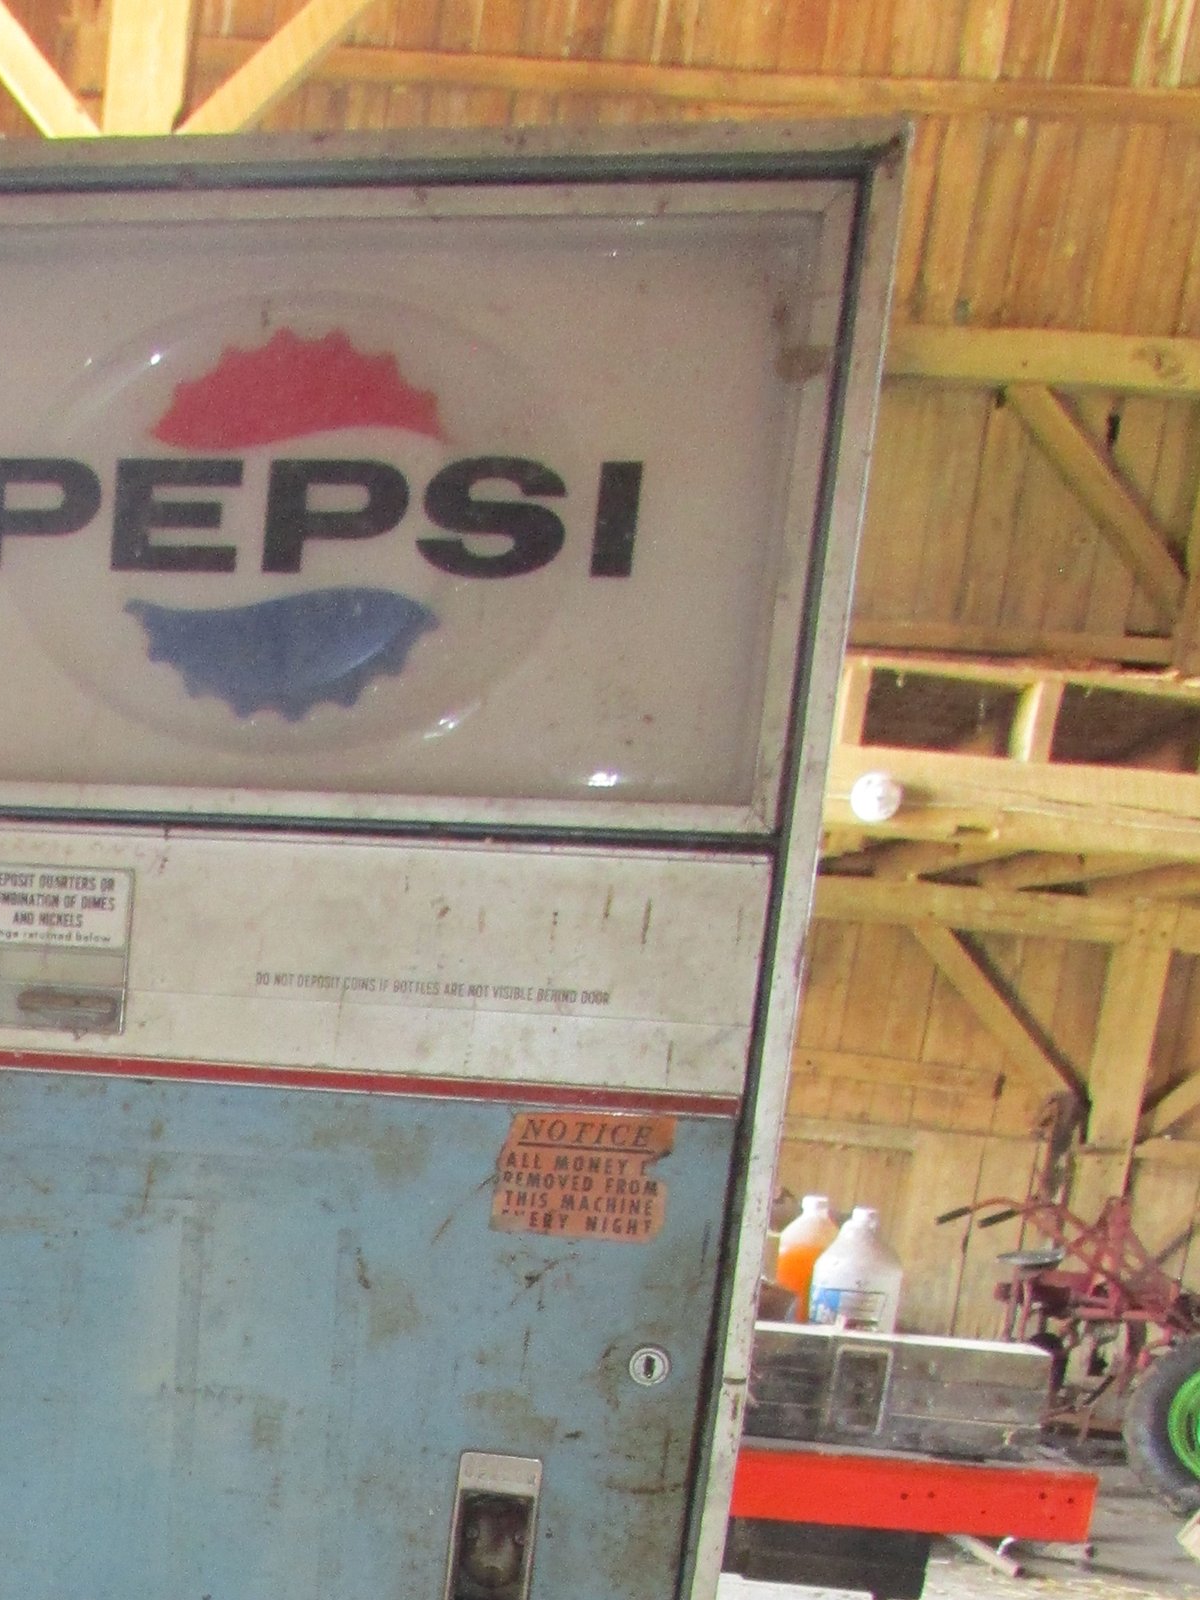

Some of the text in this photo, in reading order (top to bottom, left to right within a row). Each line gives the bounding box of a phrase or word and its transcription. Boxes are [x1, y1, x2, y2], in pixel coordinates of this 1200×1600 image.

[39, 874, 97, 891] QUARTERS
[100, 877, 115, 892] OR
[63, 895, 77, 908] OF
[81, 896, 116, 911] DIMES
[12, 911, 84, 928] AND NICKELS
[23, 930, 72, 942] returned
[75, 931, 112, 943] below
[255, 972, 611, 1006] DO NOT DEPOSIT COINS IF BOTTLES ARE NOT VISIBLE BEHIND DOOR
[521, 1119, 654, 1147] NOTICE
[506, 1152, 542, 1169] ALL
[555, 1156, 628, 1174] MONEY
[503, 1171, 658, 1196] REMOVED FROM
[505, 1191, 653, 1216] THIS MACHINE
[502, 1209, 653, 1235] ERY NIGHT
